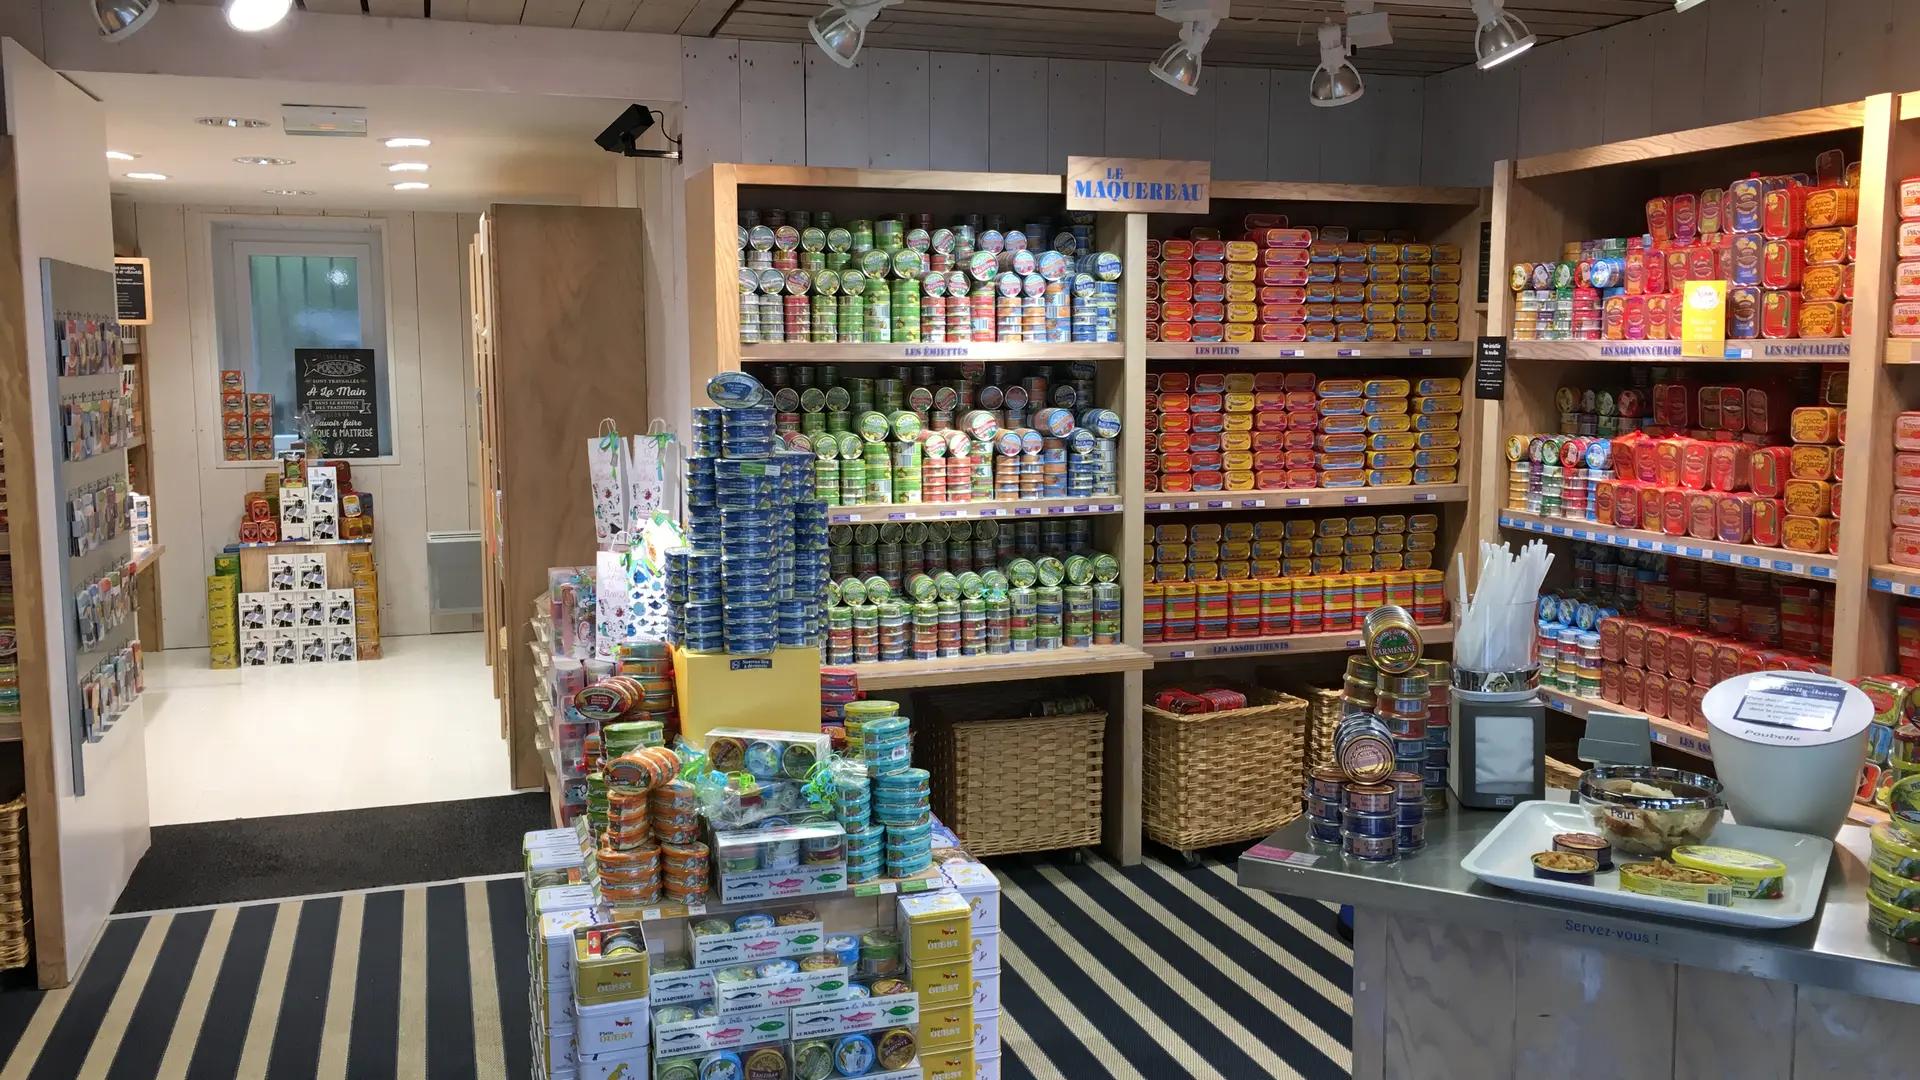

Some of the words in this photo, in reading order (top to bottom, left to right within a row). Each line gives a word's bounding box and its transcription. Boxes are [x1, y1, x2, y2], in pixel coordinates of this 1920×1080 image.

[1107, 168, 1124, 179] LE
[1075, 180, 1203, 202] MAQUEREAU
[905, 348, 921, 356] LES
[924, 346, 968, 356] ÉMIETTÉS
[1195, 347, 1210, 355] LES
[1212, 347, 1239, 355] FILETS
[1614, 346, 1650, 356] SARDINES
[1764, 345, 1781, 355] LES
[1783, 342, 1850, 355] SPÉCIALITÉS
[317, 362, 360, 375] POISSONS
[306, 385, 318, 397] À
[320, 386, 334, 398] La
[336, 386, 367, 397] Main
[332, 428, 338, 438] &
[1213, 646, 1228, 654] LES
[1230, 642, 1289, 652] ASSORTIMENTS
[1373, 645, 1416, 656] PARMESANE
[1744, 729, 1801, 741] Poubelle
[1610, 807, 1635, 820] Pain
[733, 893, 764, 901] MAQUEREAU
[1565, 919, 1650, 943] Servez-vous
[1655, 934, 1659, 944] !
[928, 940, 958, 950] OUEST
[707, 956, 739, 965] MAQUEREAU
[597, 982, 632, 993] OUEST
[929, 984, 959, 994] OUEST
[662, 993, 694, 1002] MAQUEREAU
[730, 1004, 762, 1012] MAQUEREAU
[803, 1028, 835, 1036] MAQUEREAU
[930, 1028, 960, 1038] OUEST
[599, 1032, 633, 1043] OUEST
[669, 1045, 701, 1053] MAQUEREAU
